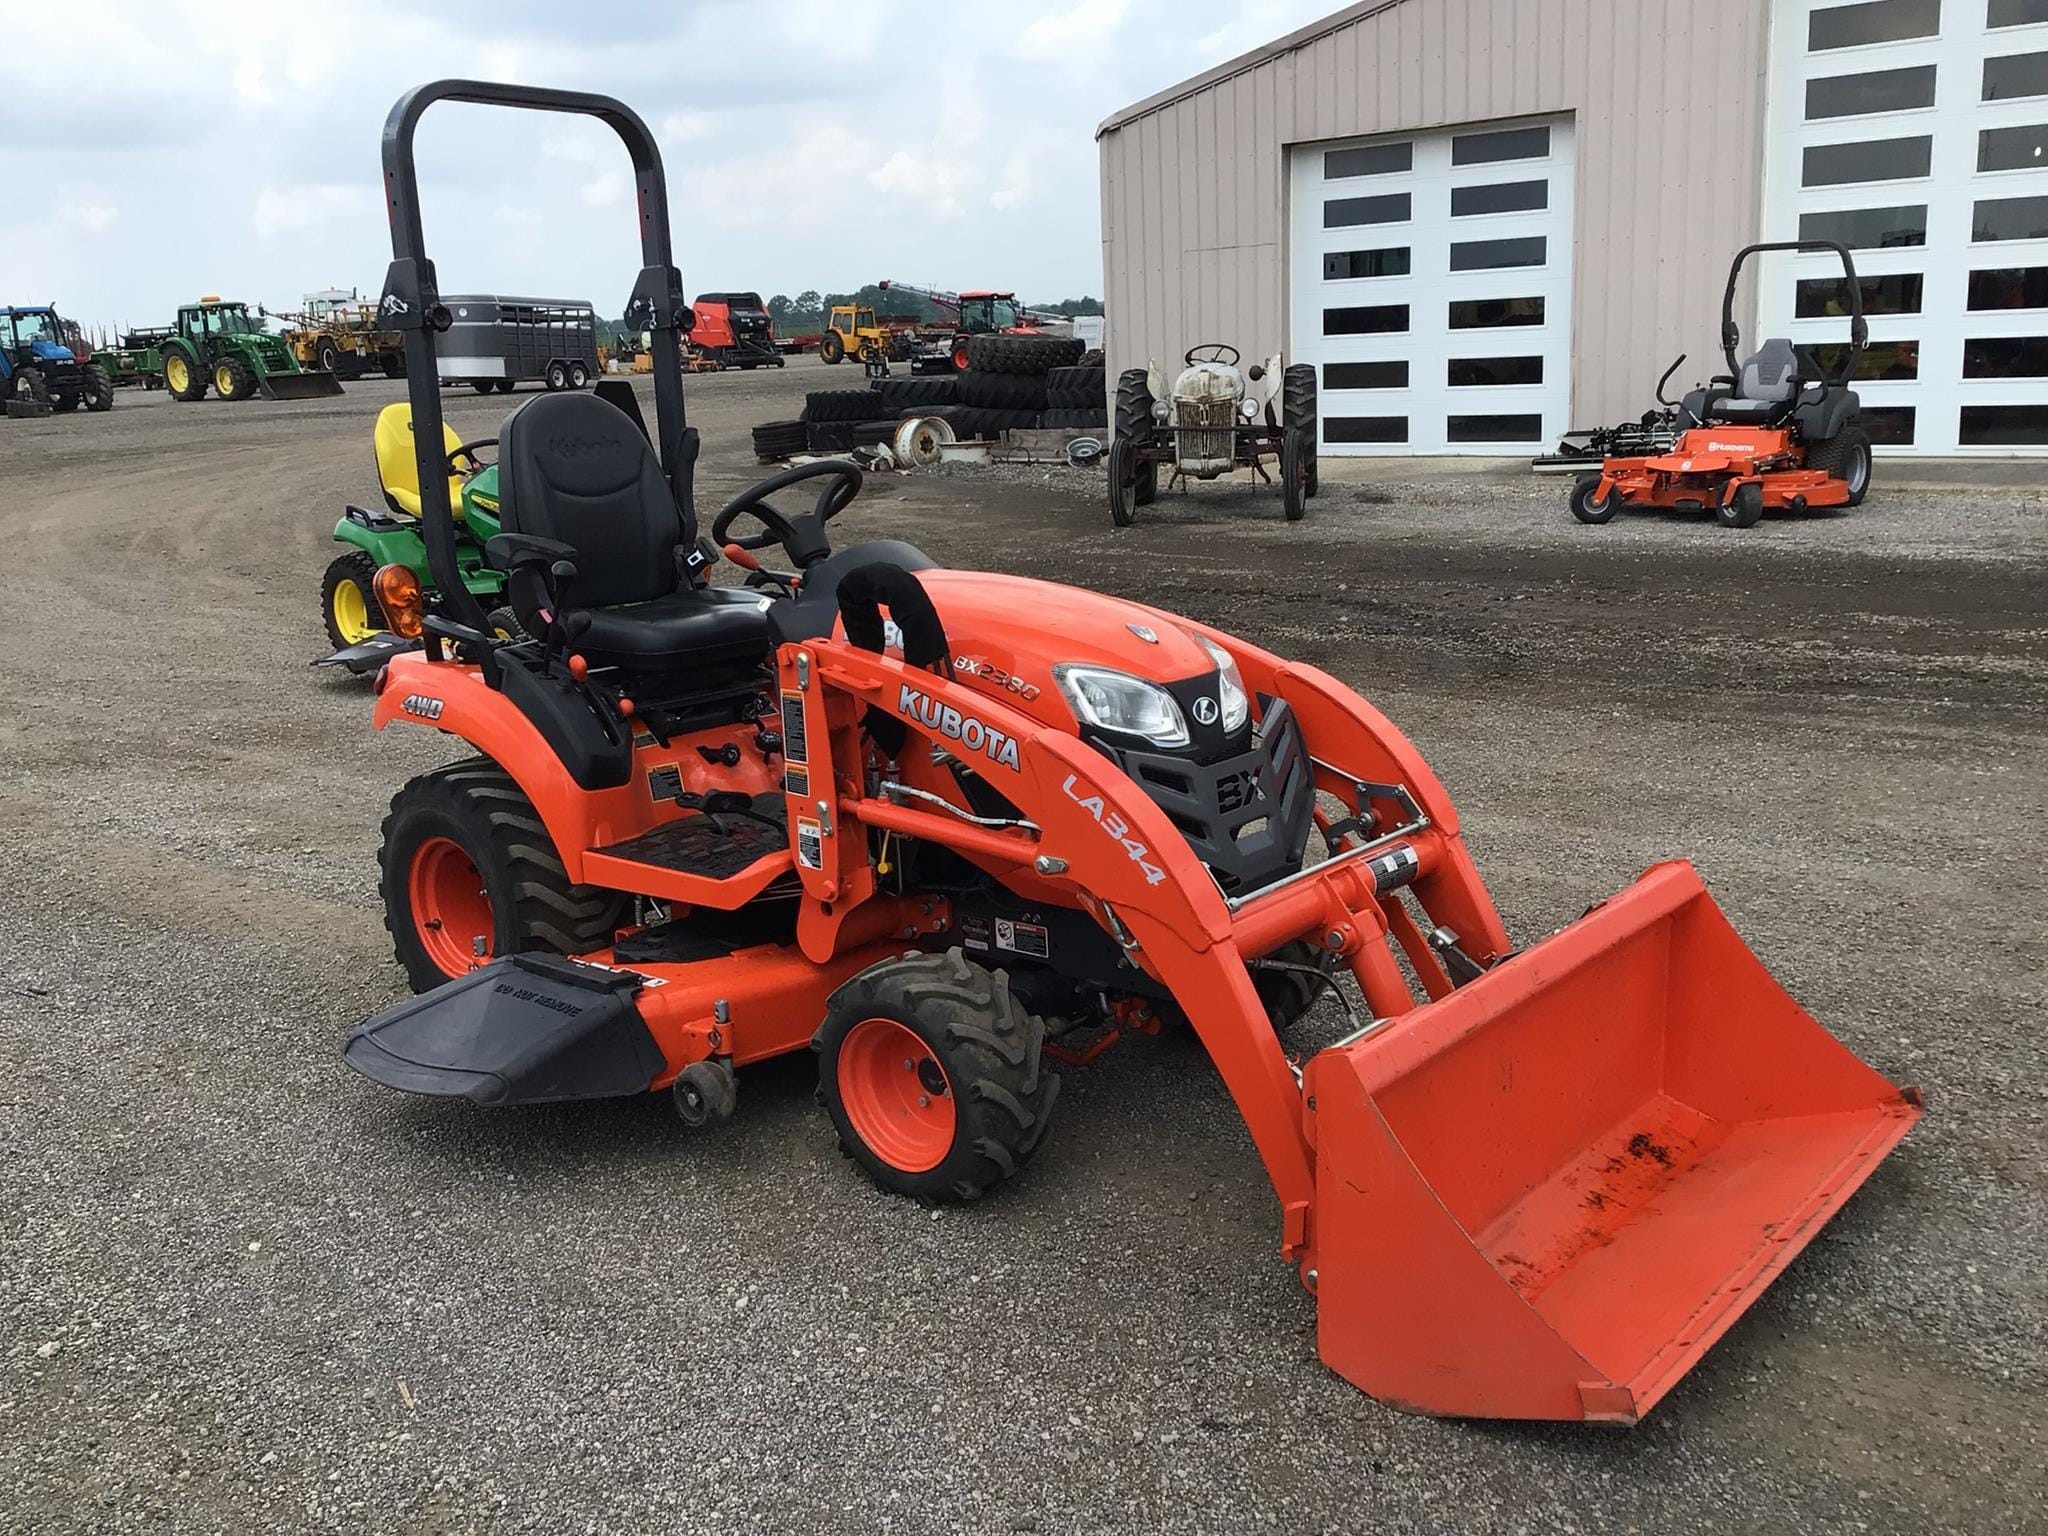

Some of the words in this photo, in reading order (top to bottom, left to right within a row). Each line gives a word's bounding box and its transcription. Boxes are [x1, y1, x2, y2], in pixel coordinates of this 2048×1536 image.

[954, 655, 1041, 702] BX2380
[400, 693, 445, 720] 4WD
[898, 682, 1022, 774] KUBOTA
[1215, 764, 1267, 816] BX
[1062, 773, 1167, 887] LA344
[494, 983, 513, 994] DO
[512, 988, 539, 1001] NOT
[534, 995, 584, 1018] REMOVE
